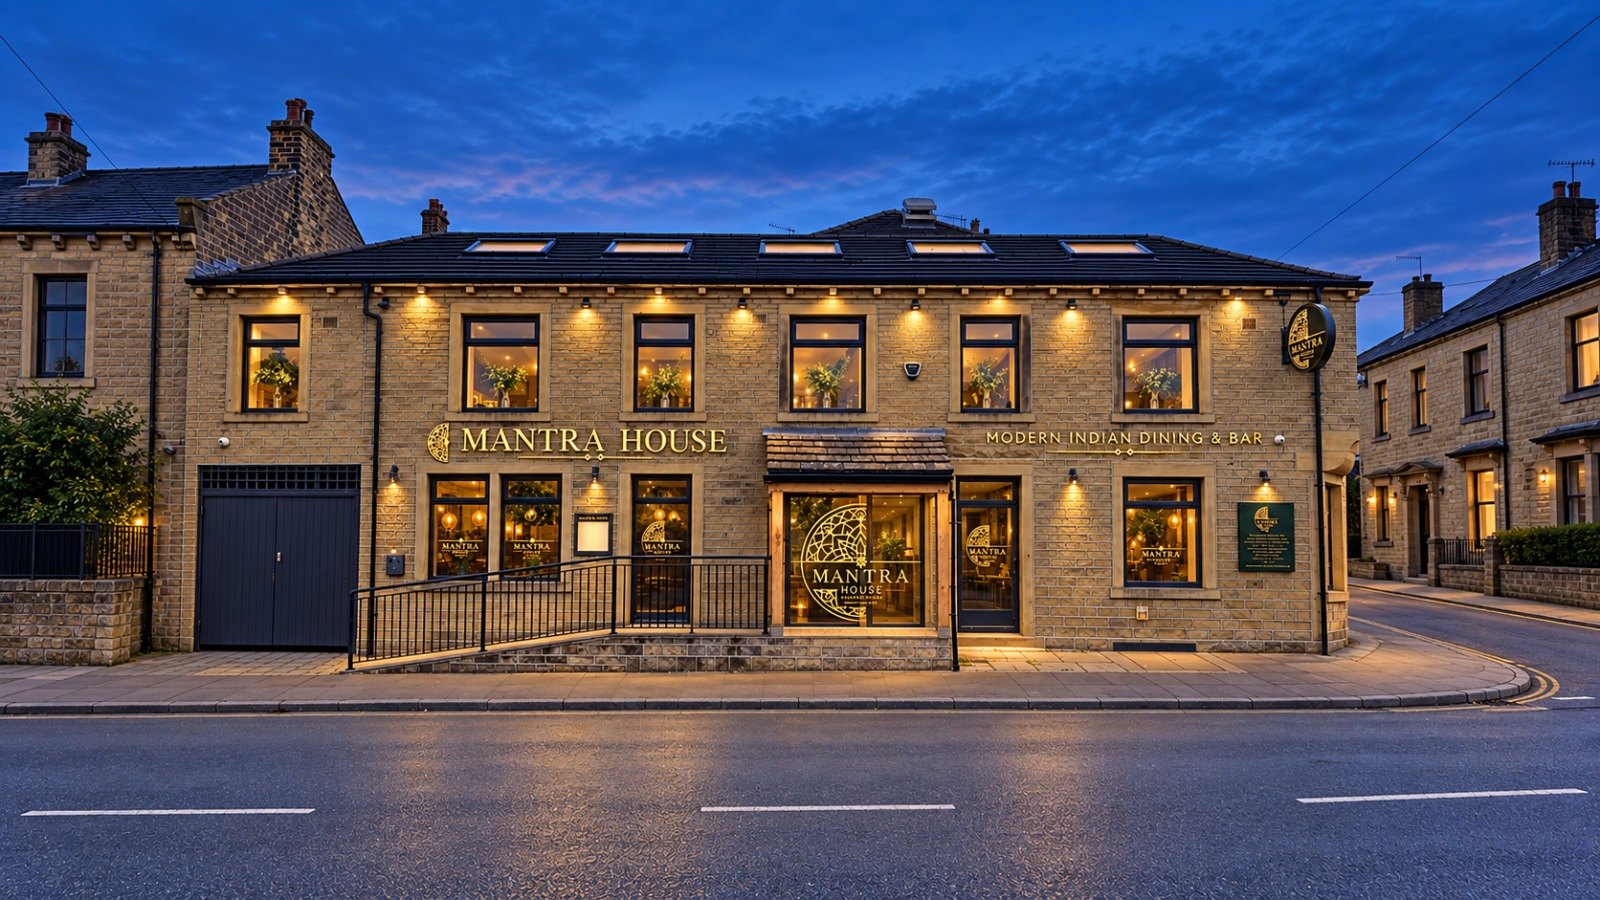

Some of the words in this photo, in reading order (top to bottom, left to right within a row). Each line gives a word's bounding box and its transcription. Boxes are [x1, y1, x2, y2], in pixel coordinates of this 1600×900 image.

[1291, 336, 1323, 354] MANTRA
[461, 427, 605, 452] MANTRA
[620, 428, 728, 453] HOUSE
[986, 431, 1061, 445] MODERN
[1069, 431, 1132, 445] INDIAN
[1139, 431, 1203, 445] DINING
[1211, 431, 1222, 445] &
[1229, 431, 1263, 445] BAR
[442, 542, 479, 550] MANTRA
[513, 542, 551, 550] MANTRA
[969, 548, 1007, 556] MANTRA
[1142, 550, 1181, 558] MANTRA
[812, 568, 910, 584] MANTRA
[840, 585, 883, 595] HOUSE
